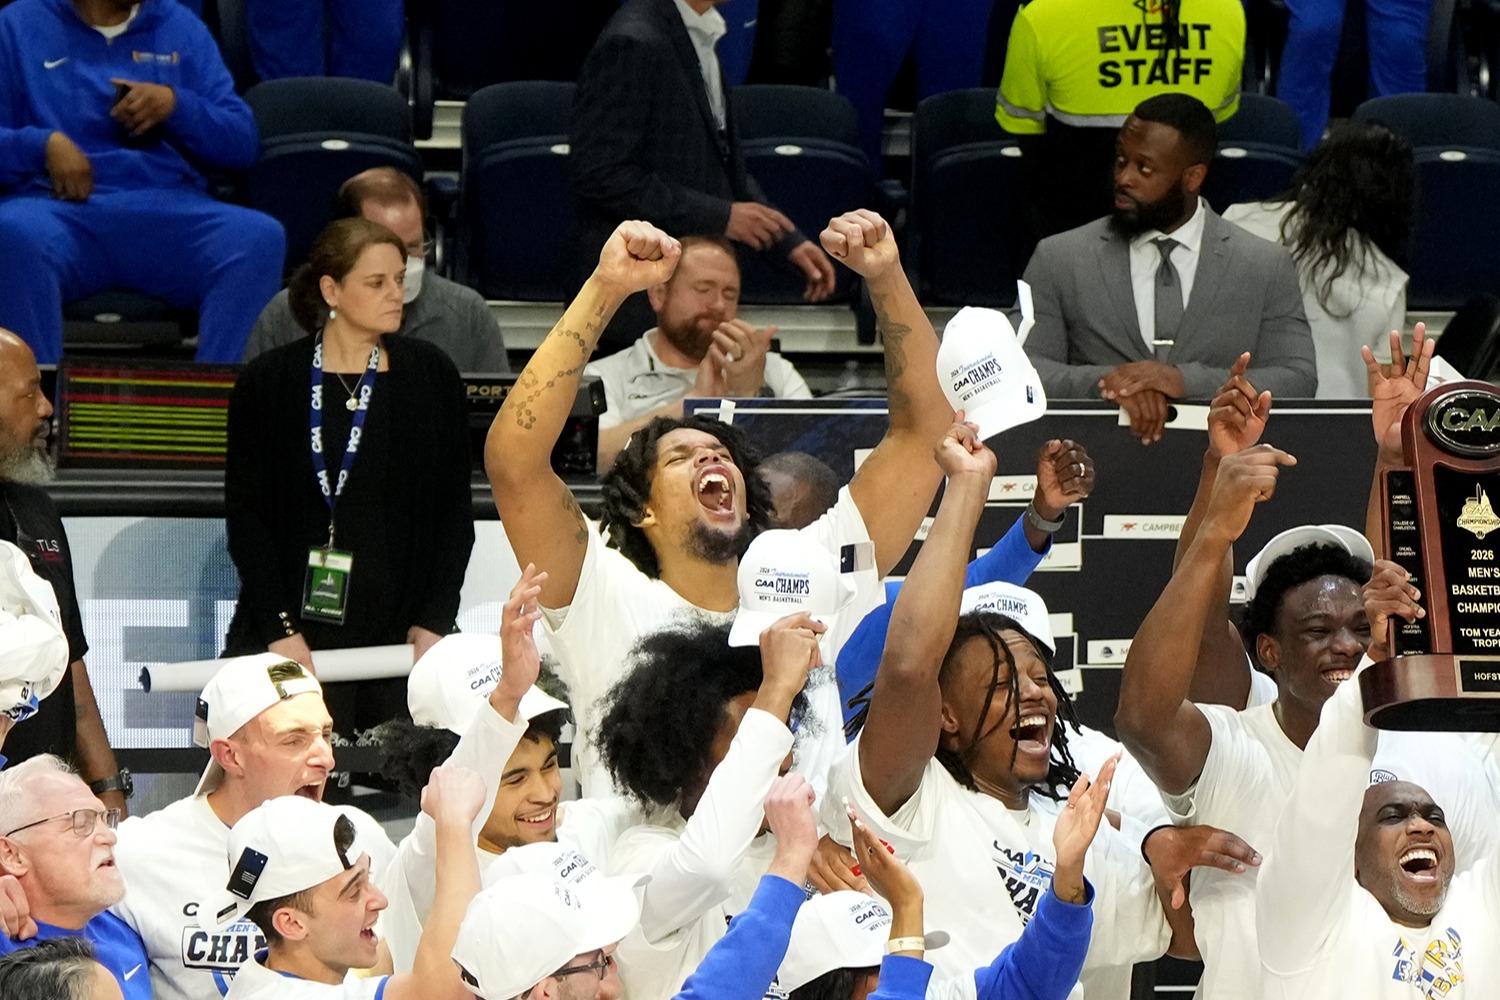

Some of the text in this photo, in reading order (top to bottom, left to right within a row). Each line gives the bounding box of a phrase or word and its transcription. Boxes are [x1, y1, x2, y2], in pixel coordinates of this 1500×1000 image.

[1097, 24, 1211, 52] EVENT
[1098, 58, 1212, 88] STAFF
[312, 344, 322, 368] CAA
[368, 347, 379, 369] CAA
[954, 358, 1002, 392] CAA CHAMPS
[974, 378, 1001, 395] BASKETBALL
[312, 385, 322, 410] CAA
[358, 385, 372, 410] CAA
[312, 426, 322, 452] CAA
[346, 426, 362, 452] CAA
[317, 470, 330, 496] CAA
[335, 470, 348, 495] CAA
[1462, 504, 1492, 516] CAA
[1142, 523, 1180, 532] CAMPBE
[36, 539, 60, 552] TLS
[1470, 550, 1494, 560] 2026
[771, 568, 810, 578] Tournament
[1468, 568, 1500, 578] MEN'S
[755, 578, 810, 594] CAA CHAMPS
[974, 599, 1028, 615] CAA CHAMPS
[1460, 628, 1480, 637] TOM
[470, 675, 492, 690] CAA
[560, 862, 577, 878] CAA
[1022, 874, 1043, 886] MEN
[855, 910, 875, 924] CAA
